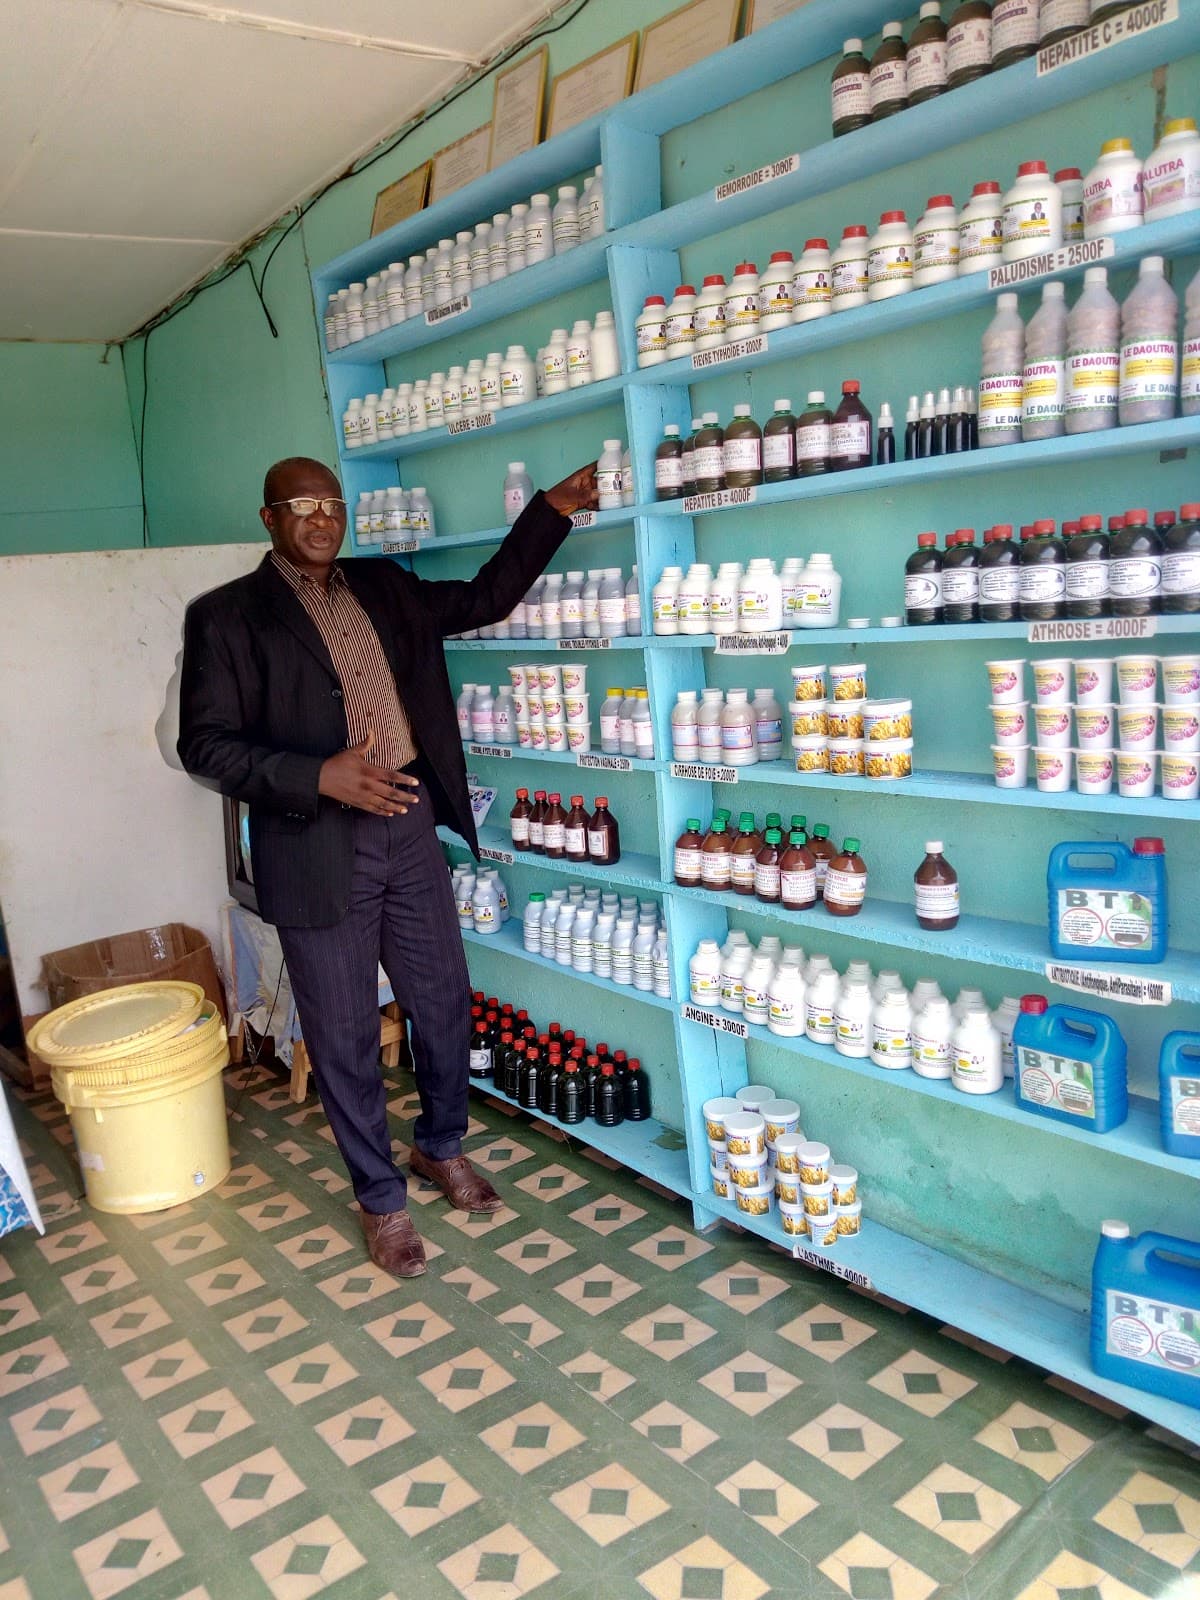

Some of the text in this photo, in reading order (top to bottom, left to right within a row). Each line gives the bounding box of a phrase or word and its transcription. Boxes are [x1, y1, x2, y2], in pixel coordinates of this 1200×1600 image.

[1039, 1, 1167, 72] HEPATITE C = 4000F
[717, 170, 763, 200] HEMORROIDE
[765, 169, 769, 178] =
[991, 239, 1105, 288] PALUDISME = 2500F
[1124, 344, 1175, 358] LE DAOUTRA
[693, 351, 712, 368] FIEVRE
[1072, 359, 1081, 368] LE
[985, 379, 1023, 390] DAOUTRA
[1145, 384, 1154, 393] LE
[1094, 395, 1105, 404] LE
[1026, 406, 1036, 415] LE
[995, 416, 1006, 424] LE
[684, 487, 751, 512] HEPATITE B = 4000F
[573, 512, 593, 528] 2000F
[1032, 618, 1148, 641] ATHROSE = 4000F
[698, 766, 705, 779] DE
[705, 767, 716, 780] FOIE
[685, 1006, 746, 1036] ANGINE = 3000F
[797, 1246, 836, 1273] L'ASTHME
[837, 1267, 842, 1275] =
